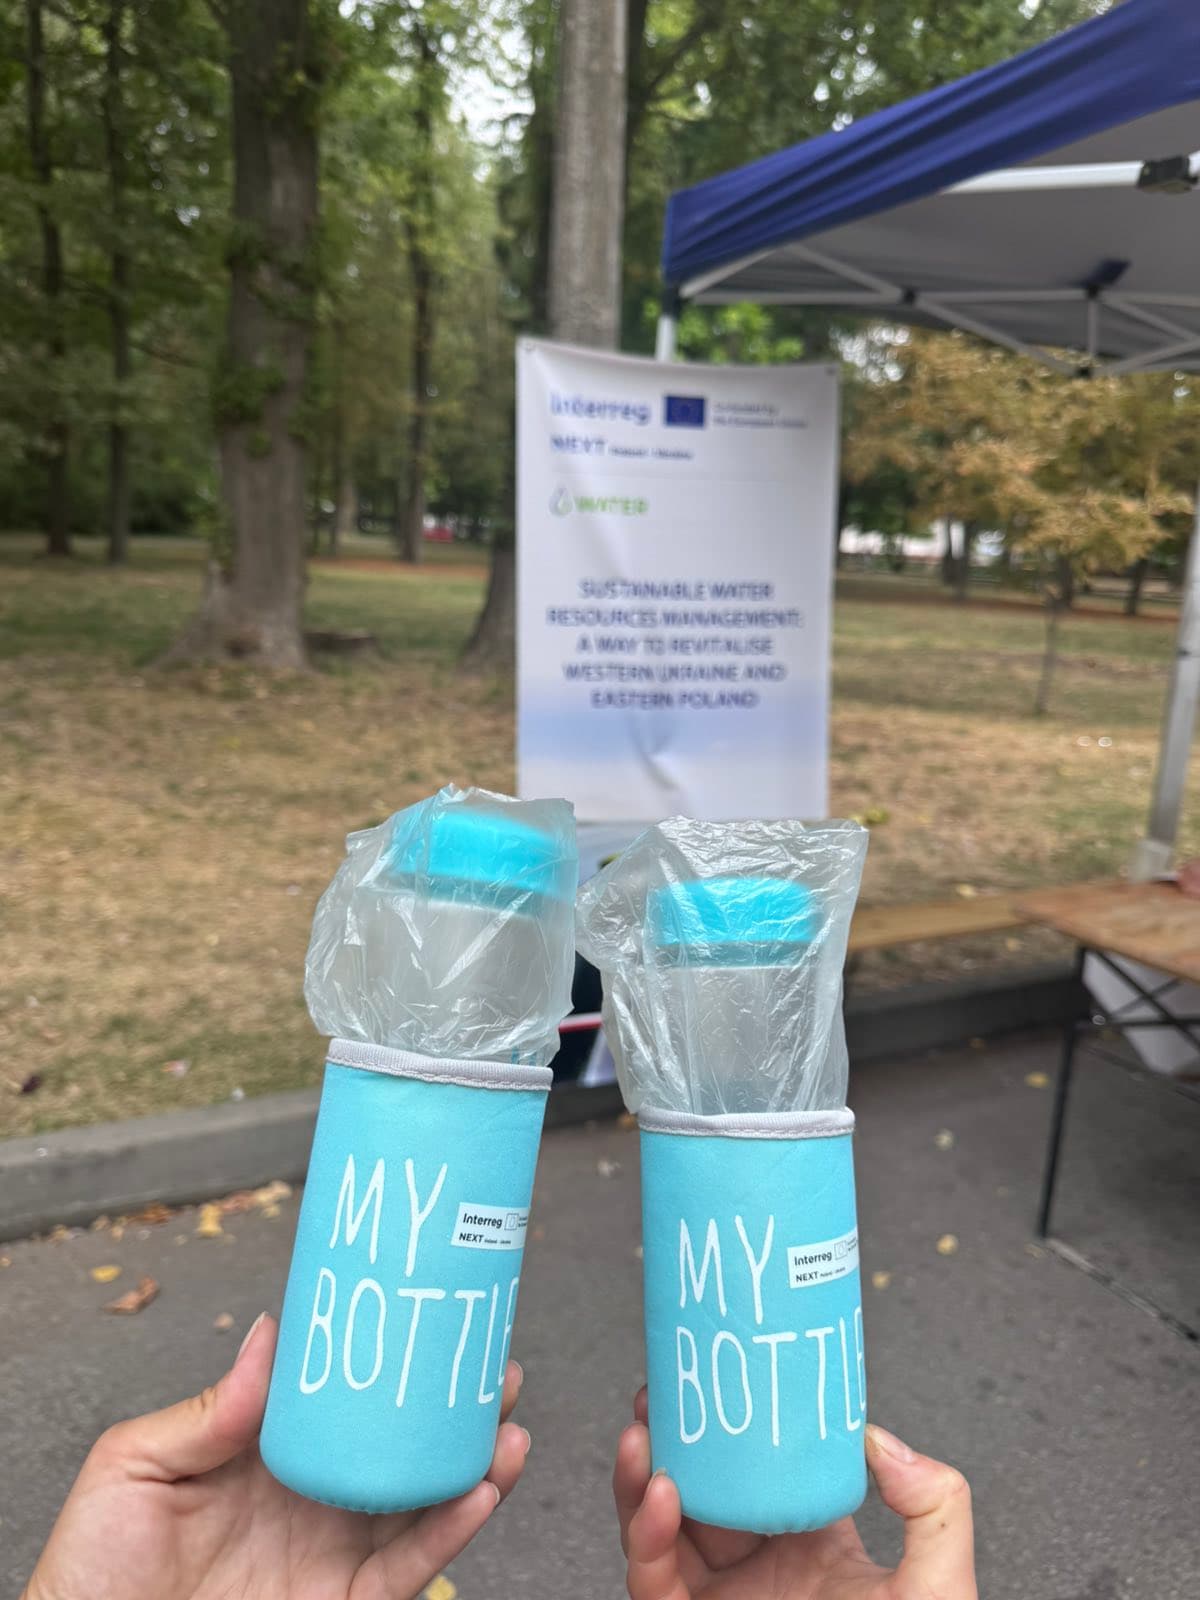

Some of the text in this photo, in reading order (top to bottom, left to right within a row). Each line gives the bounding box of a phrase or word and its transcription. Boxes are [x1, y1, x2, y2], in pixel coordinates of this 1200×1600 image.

[578, 578, 774, 600] SUSTAINABLE WATER
[546, 606, 657, 628] RESOURCES
[576, 634, 774, 656] A WAY TO REVITALISE
[562, 662, 788, 683] WESTERN UKRAINE AND
[590, 689, 761, 711] EASTERN POLAND
[329, 1153, 448, 1277] MY
[462, 1212, 503, 1229] Interreg
[458, 1232, 484, 1243] NEXT
[679, 1214, 774, 1325] MY
[794, 1251, 833, 1267] Interreg
[795, 1271, 819, 1283] NEXT
